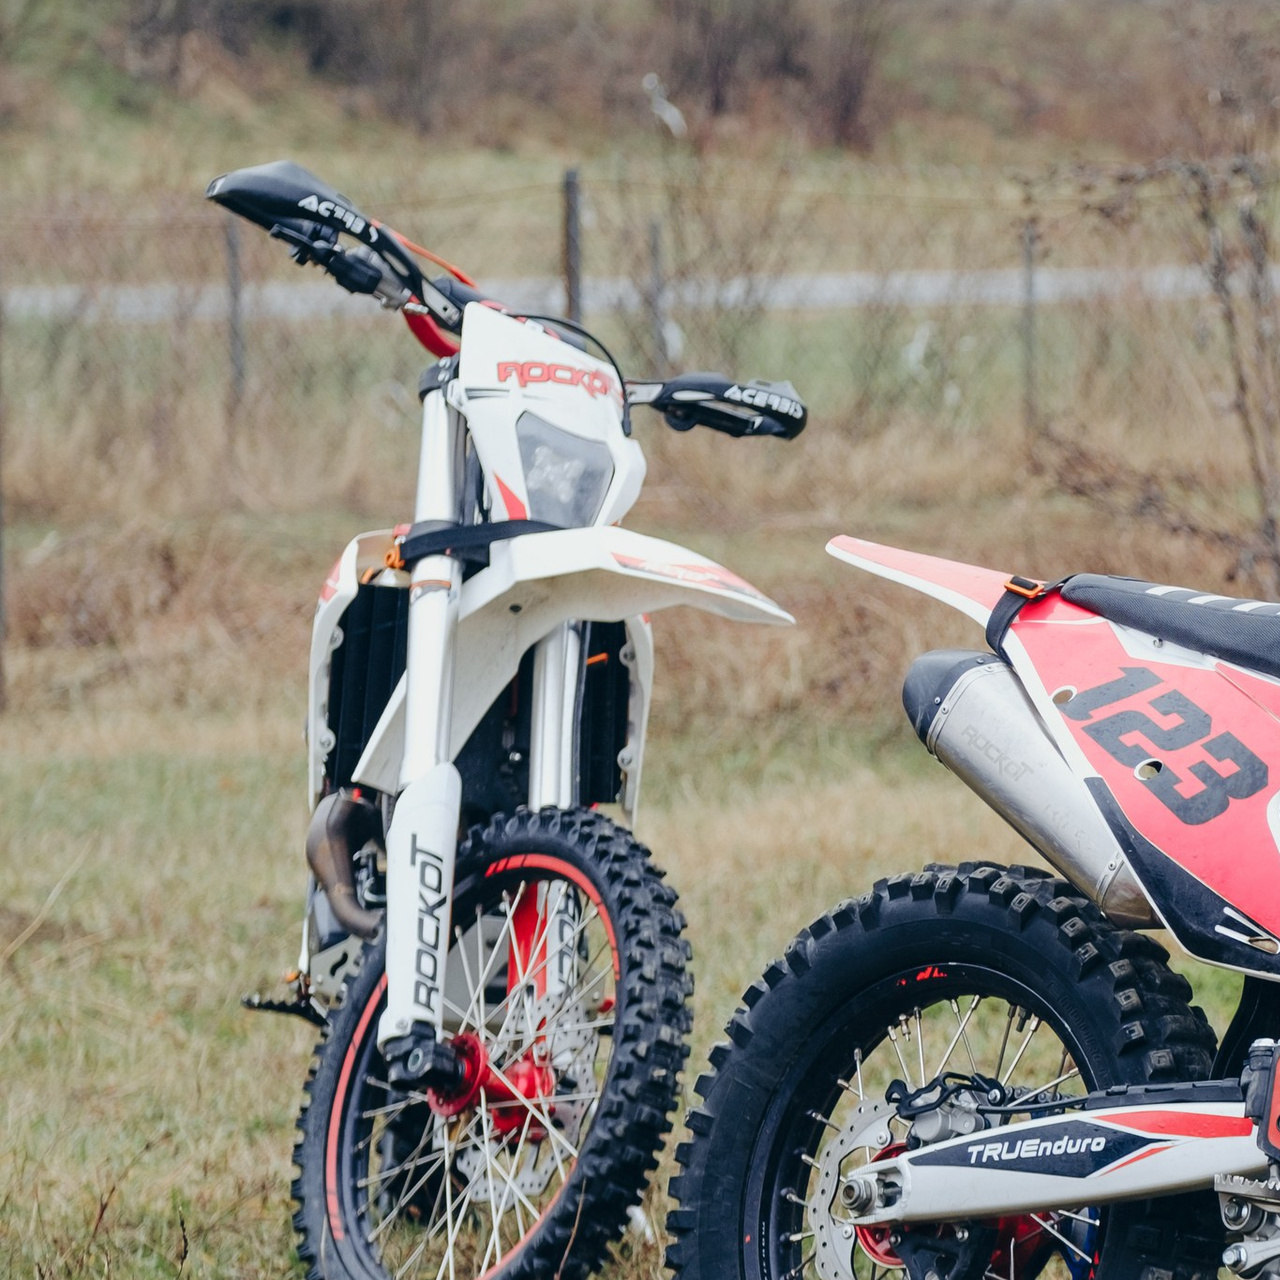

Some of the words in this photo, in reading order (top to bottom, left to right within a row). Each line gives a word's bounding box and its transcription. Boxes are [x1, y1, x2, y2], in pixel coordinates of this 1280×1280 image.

[497, 361, 618, 401] ROCKO
[960, 724, 1035, 783] ROCKOT
[1059, 666, 1268, 825] 123
[411, 833, 447, 1013] ROCKOT
[967, 1135, 1106, 1164] TRUEnduro
